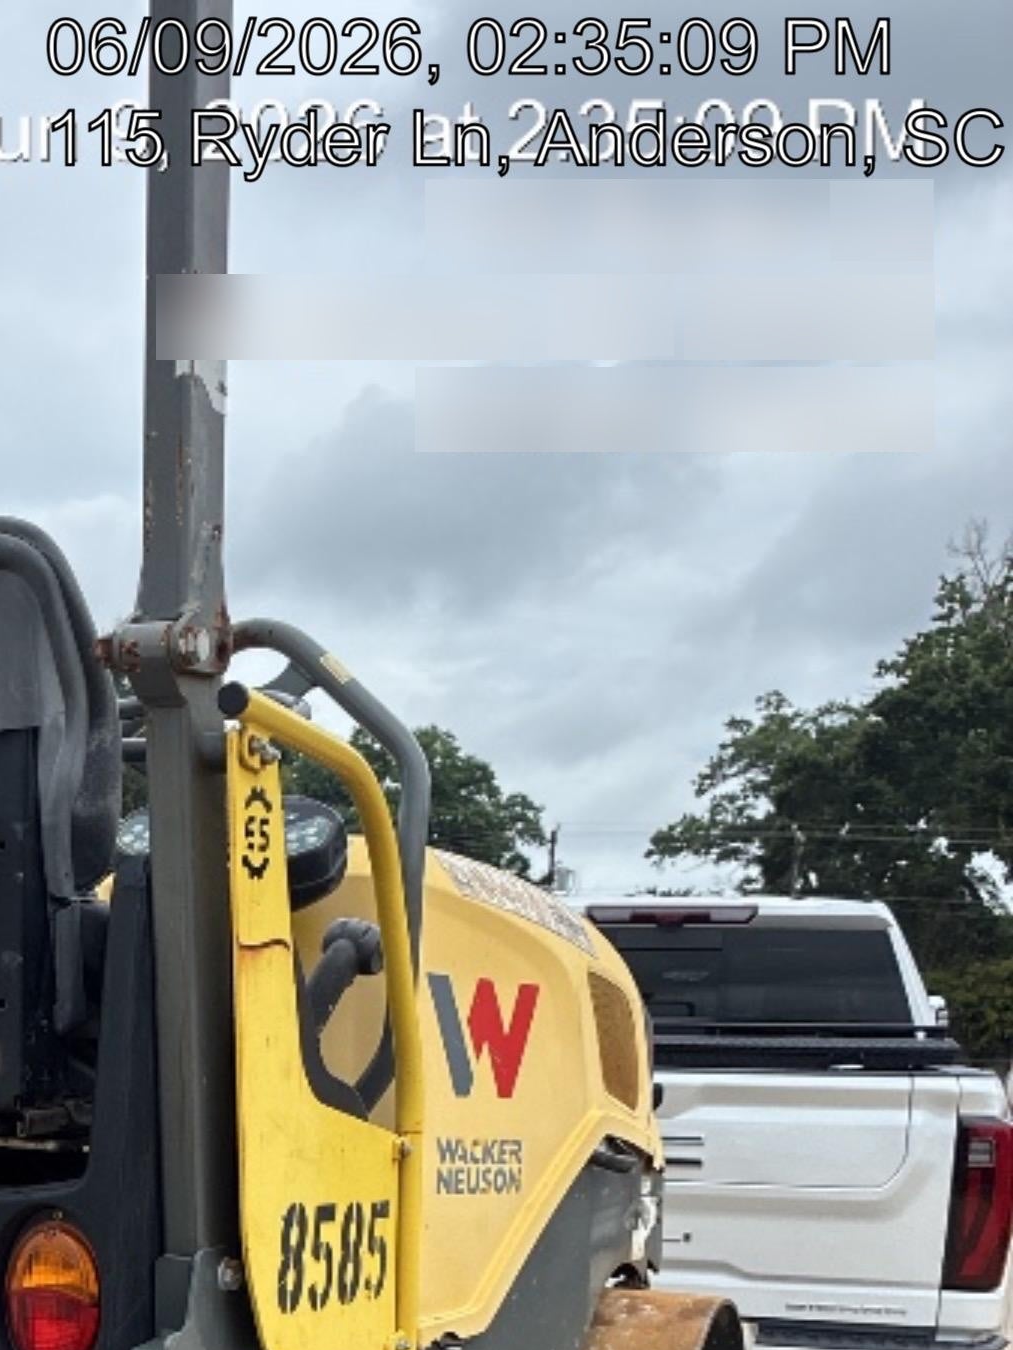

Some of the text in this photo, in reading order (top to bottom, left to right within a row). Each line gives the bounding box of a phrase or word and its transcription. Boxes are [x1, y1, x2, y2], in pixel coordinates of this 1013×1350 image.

[244, 815, 270, 852] ES
[436, 1137, 523, 1166] WACKER
[436, 1165, 523, 1196] NEUSON
[277, 1199, 391, 1314] 8585
